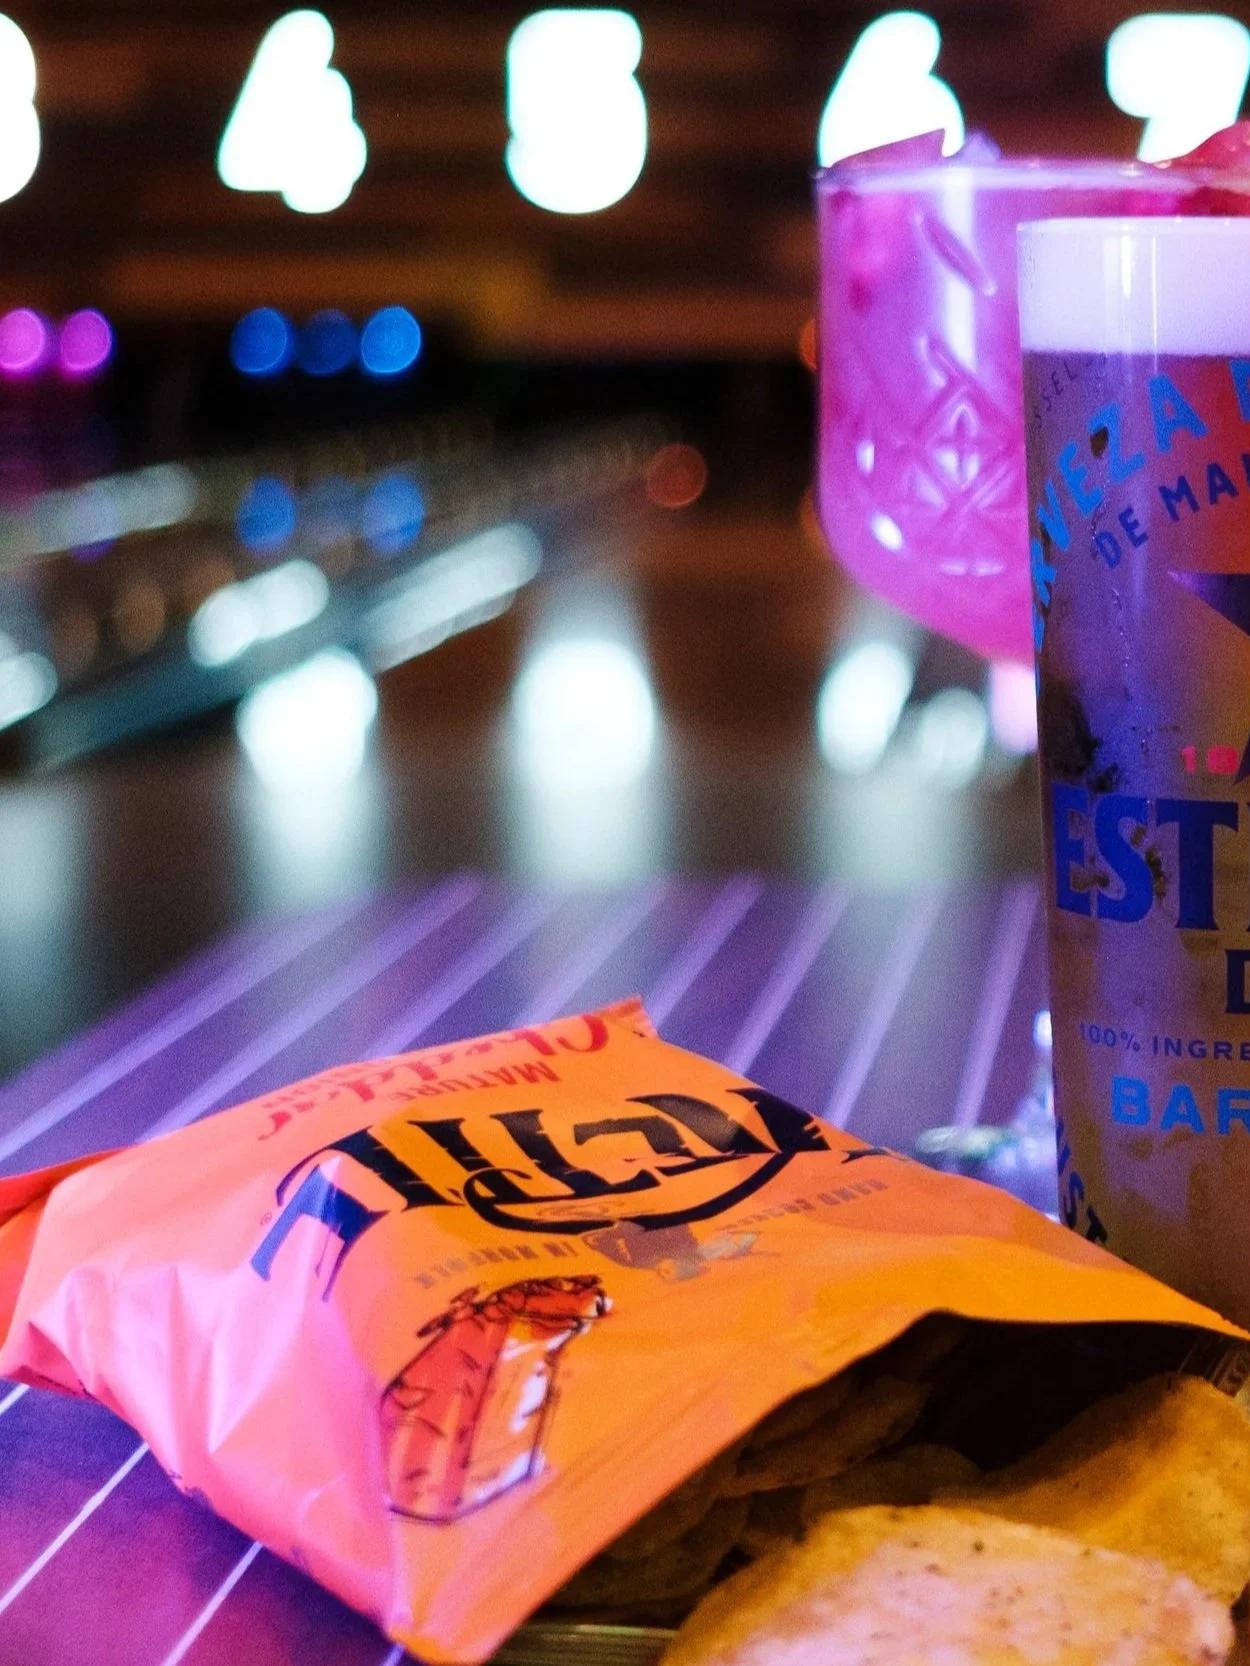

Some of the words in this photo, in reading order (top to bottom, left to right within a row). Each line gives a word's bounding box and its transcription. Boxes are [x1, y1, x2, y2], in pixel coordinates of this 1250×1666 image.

[217, 9, 368, 214] 4
[506, 8, 648, 214] 5
[1031, 373, 1209, 690] RVEZA
[1093, 505, 1149, 569] DE
[389, 1060, 562, 1101] MATURE
[1079, 1020, 1142, 1054] 100%
[249, 1088, 835, 1303] KETTLE
[543, 1241, 578, 1258] IN
